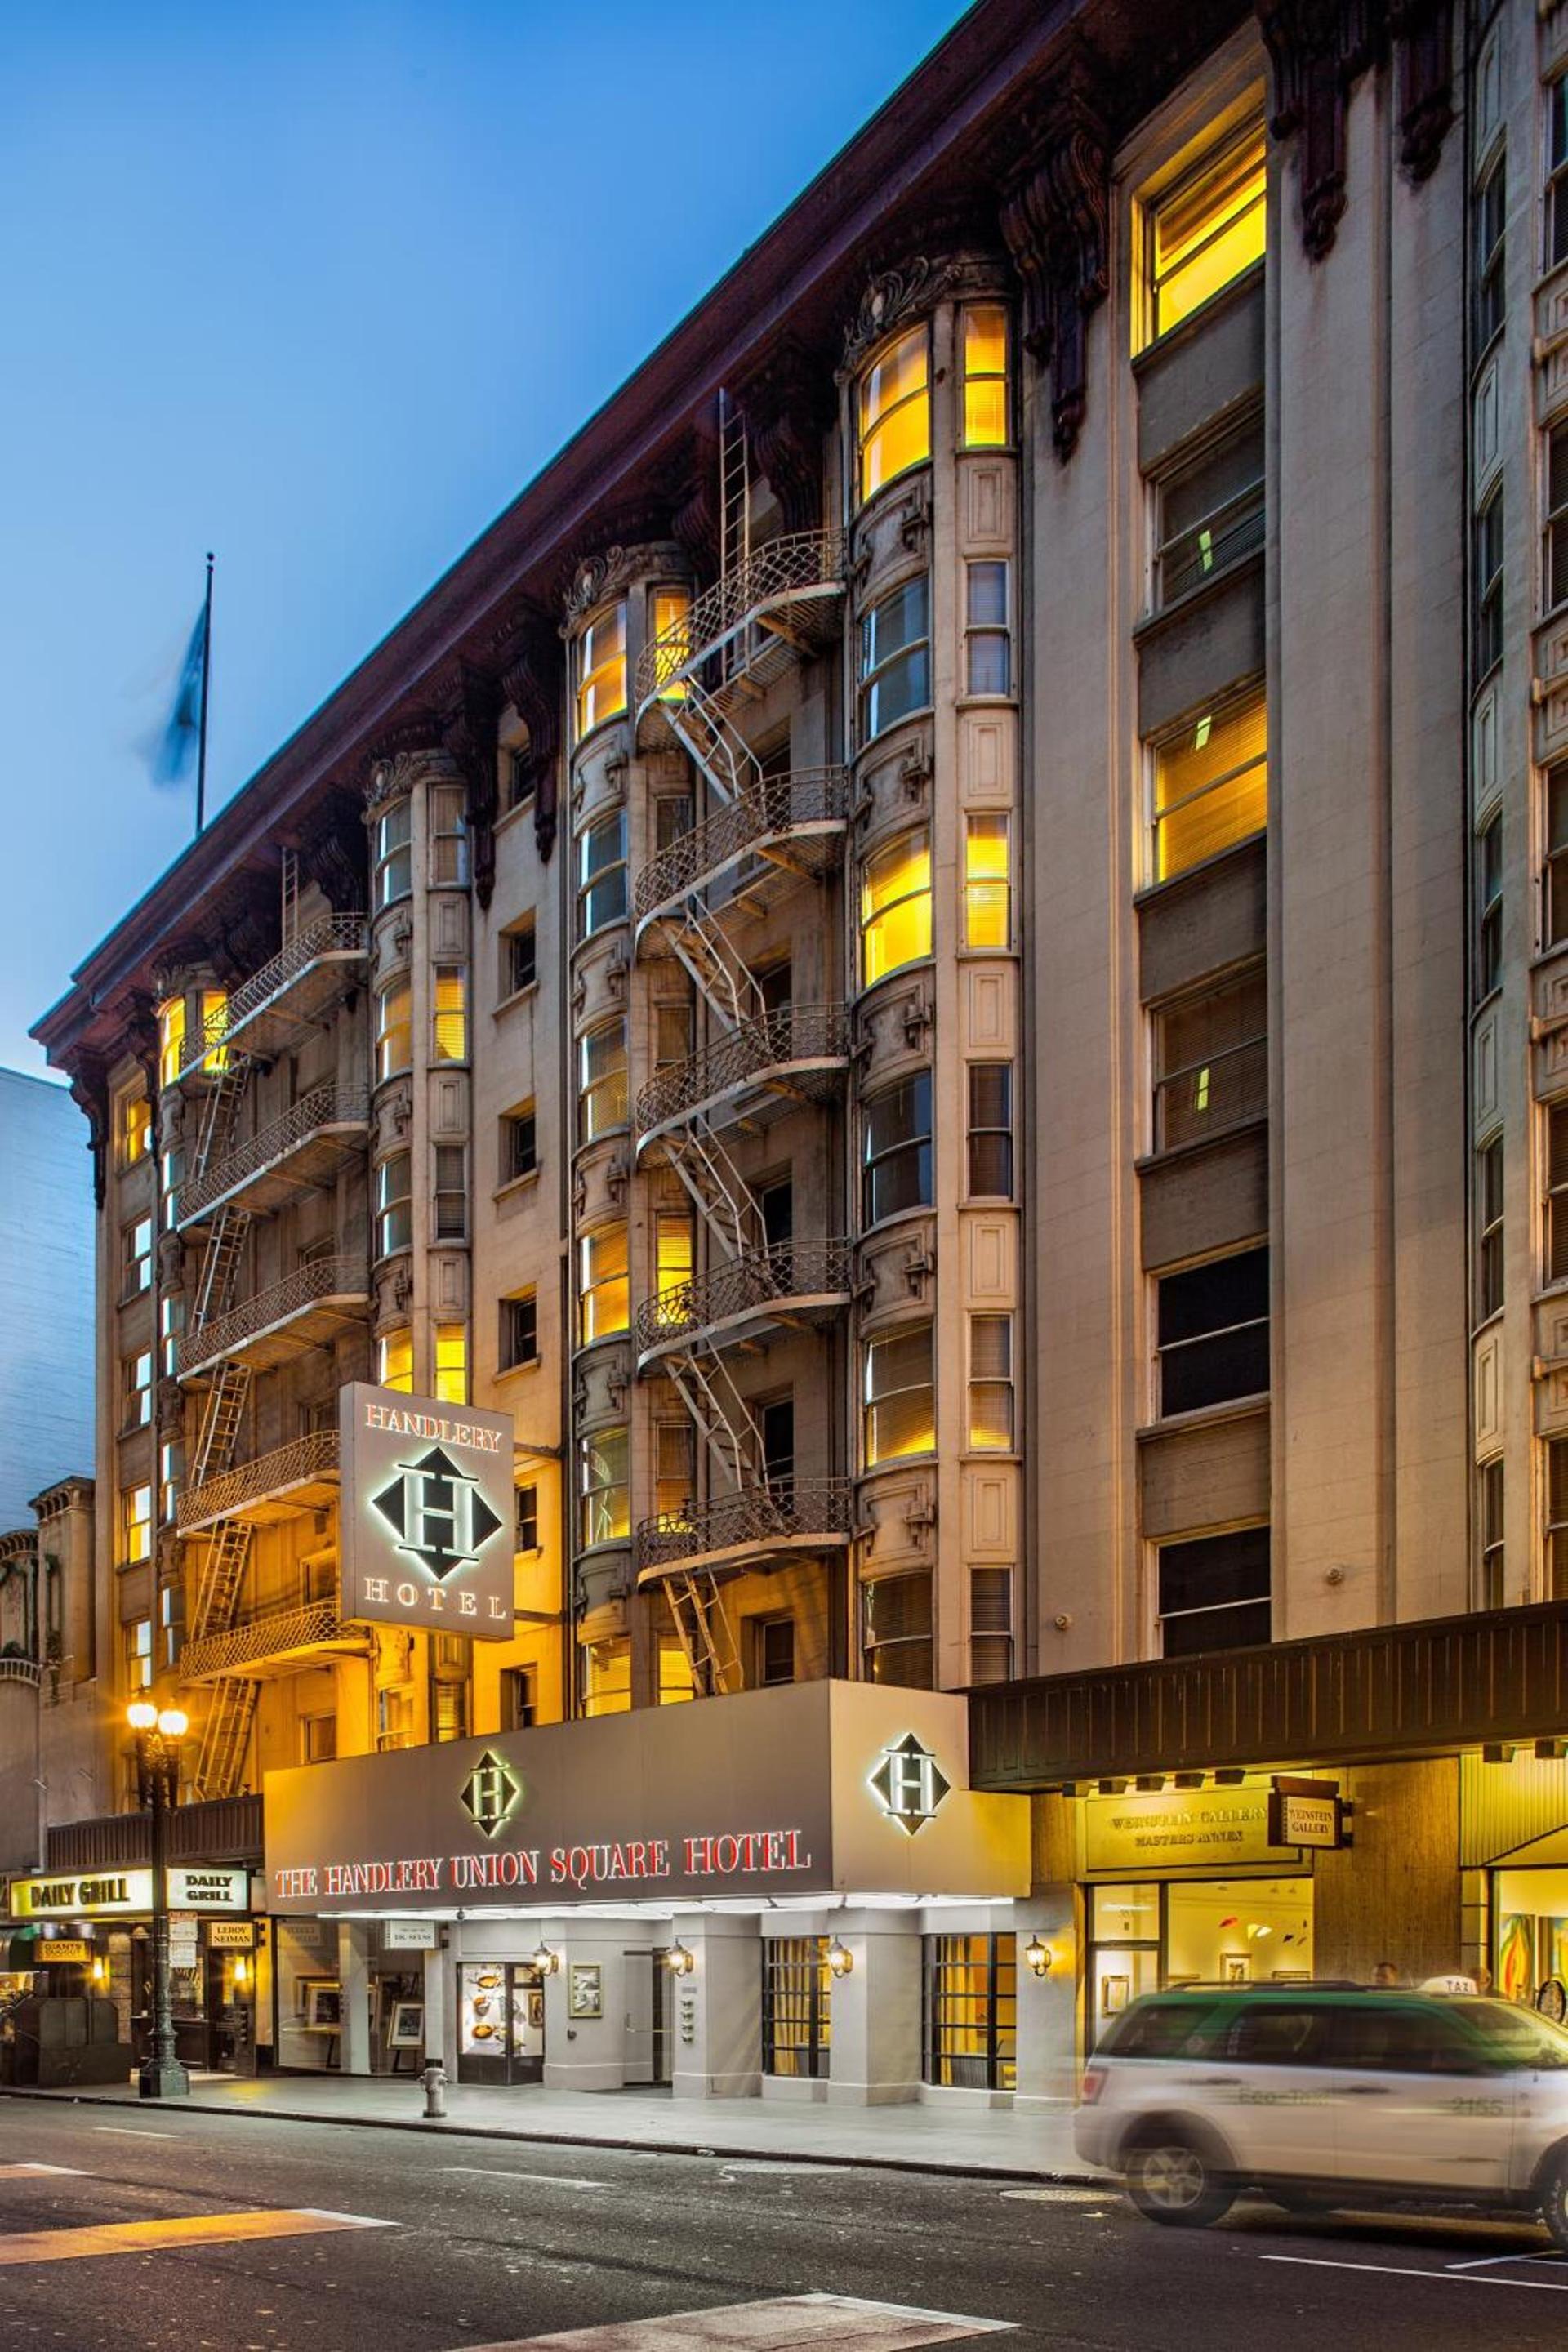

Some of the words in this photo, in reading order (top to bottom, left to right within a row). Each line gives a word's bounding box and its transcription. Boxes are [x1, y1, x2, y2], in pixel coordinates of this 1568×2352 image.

[365, 1404, 502, 1453] HANDLERY
[397, 1463, 479, 1561] H
[364, 1578, 506, 1620] HOTEL
[882, 1748, 937, 1818] H
[1199, 1807, 1267, 1824] GALLERY
[1289, 1808, 1333, 1821] WEINSTEIN
[1292, 1821, 1330, 1833] GALLERY
[1134, 1835, 1195, 1847] MASTERS
[275, 1868, 318, 1899] THE
[324, 1857, 443, 1895] HANDLERY
[449, 1850, 540, 1888] UNION
[550, 1839, 670, 1890] SQUARE
[684, 1829, 812, 1876] HOTEL
[185, 1875, 233, 1886] DAILY
[30, 1883, 76, 1908] DAILY
[78, 1878, 131, 1905] GRILL
[186, 1891, 234, 1902] GRILL
[216, 1926, 248, 1935] LEROY
[1446, 1980, 1473, 1993] TAX
